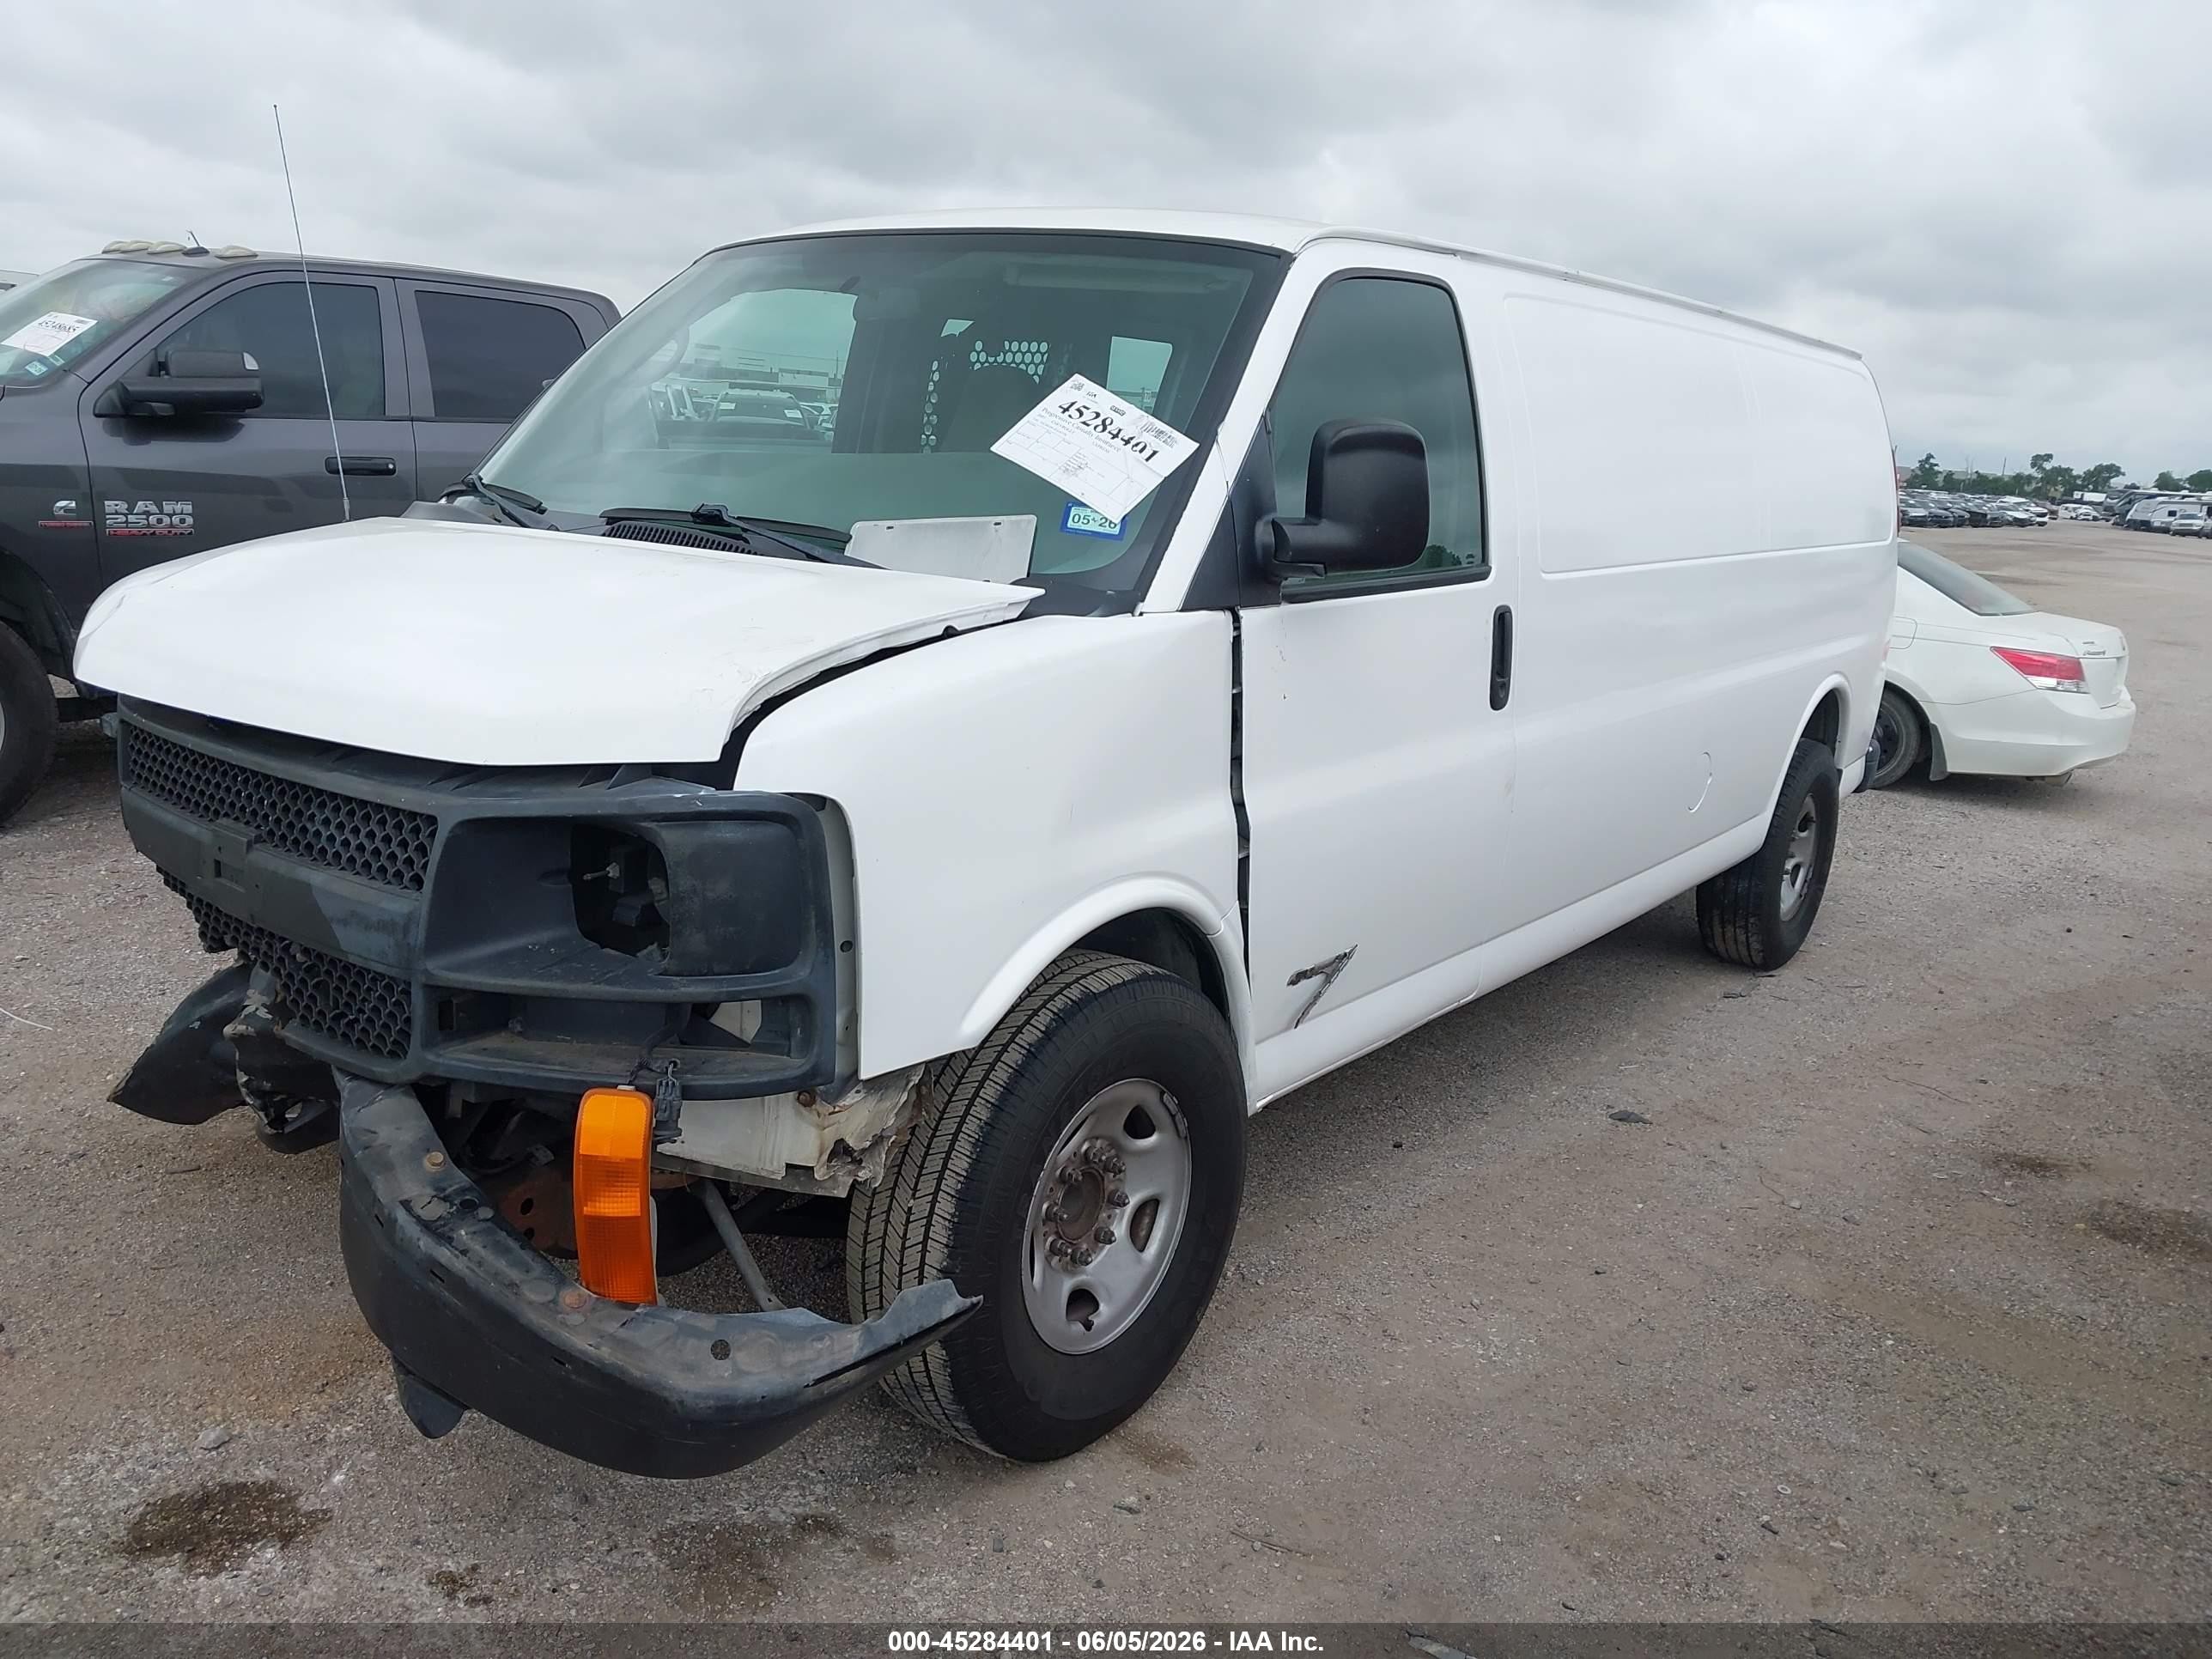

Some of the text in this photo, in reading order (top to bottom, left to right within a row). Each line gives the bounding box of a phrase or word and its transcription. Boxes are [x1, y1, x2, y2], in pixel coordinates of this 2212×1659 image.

[1058, 400, 1160, 463] 45284401
[104, 501, 192, 514] RAM
[106, 514, 193, 527] 2500
[1072, 514, 1091, 526] 05
